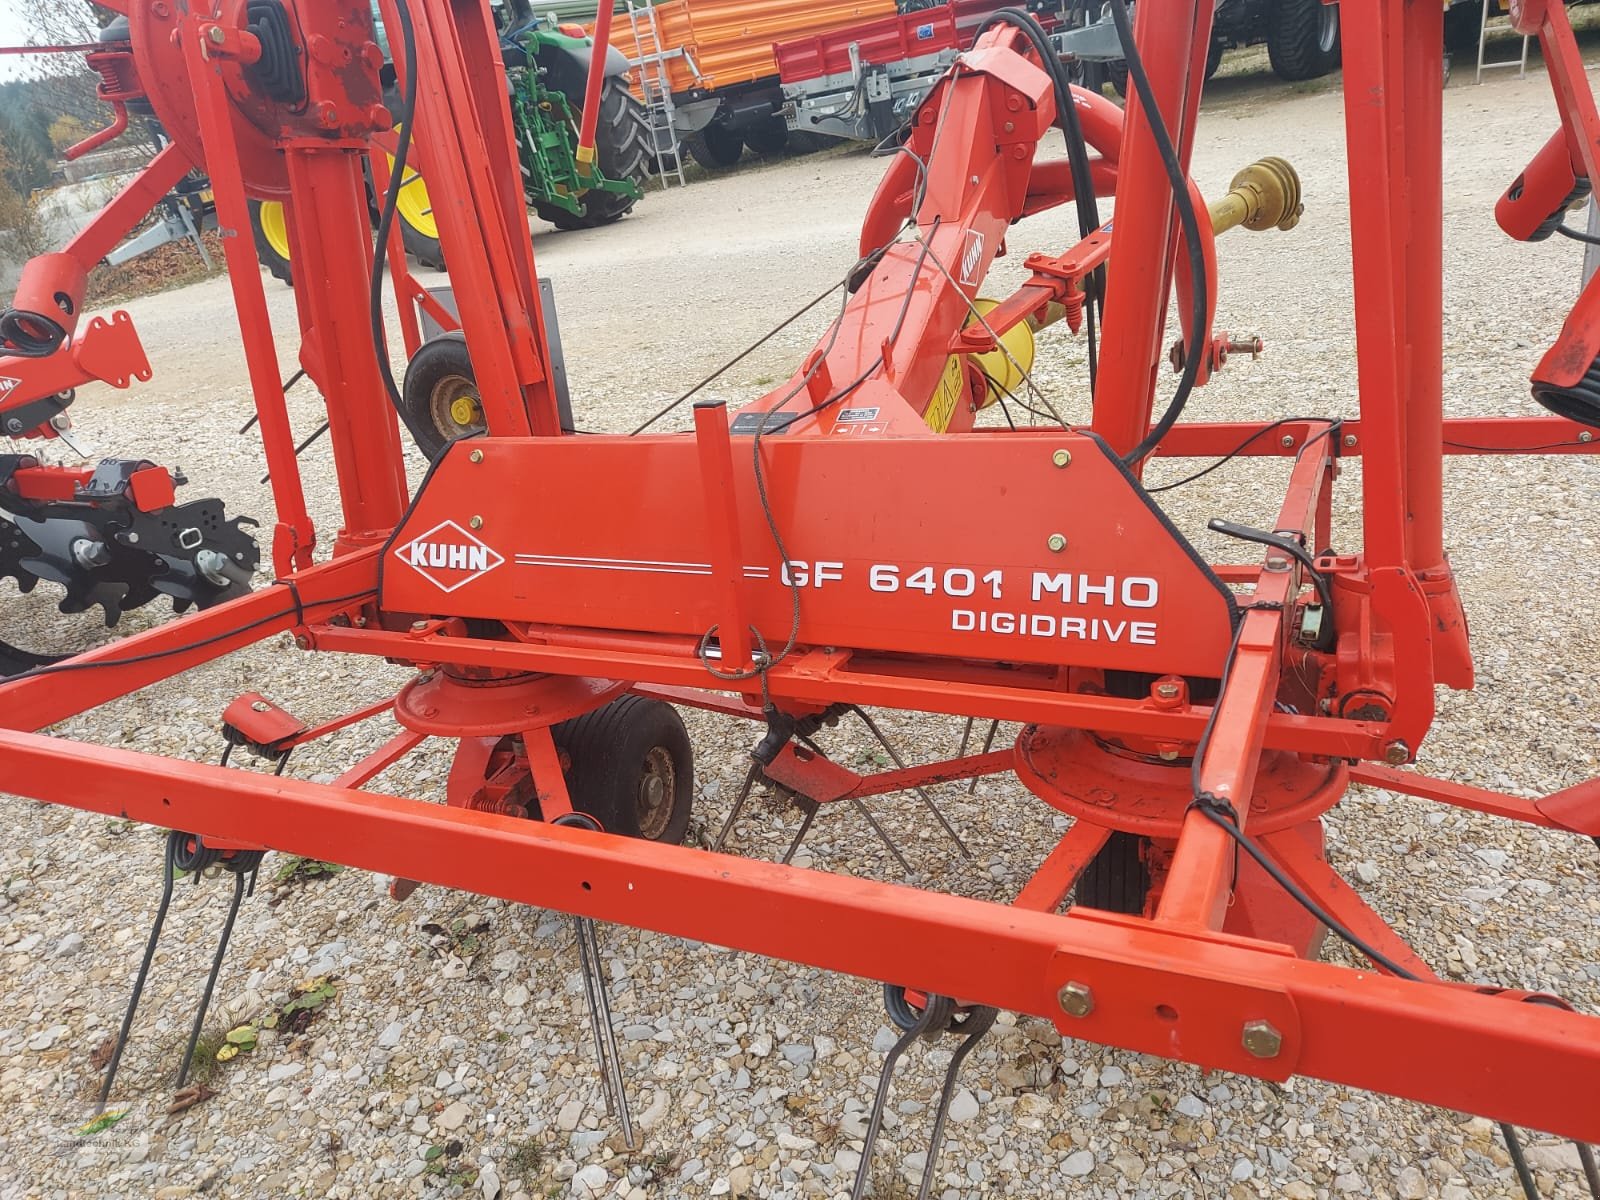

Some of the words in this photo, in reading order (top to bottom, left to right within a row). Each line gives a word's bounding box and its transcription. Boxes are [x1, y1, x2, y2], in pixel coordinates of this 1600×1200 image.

[962, 235, 982, 282] KUHN
[410, 542, 487, 571] KUHN
[781, 560, 843, 588] GF
[869, 564, 1003, 599] 6401
[1032, 572, 1159, 608] MHO
[952, 609, 1157, 645] DIGIDRIVE
